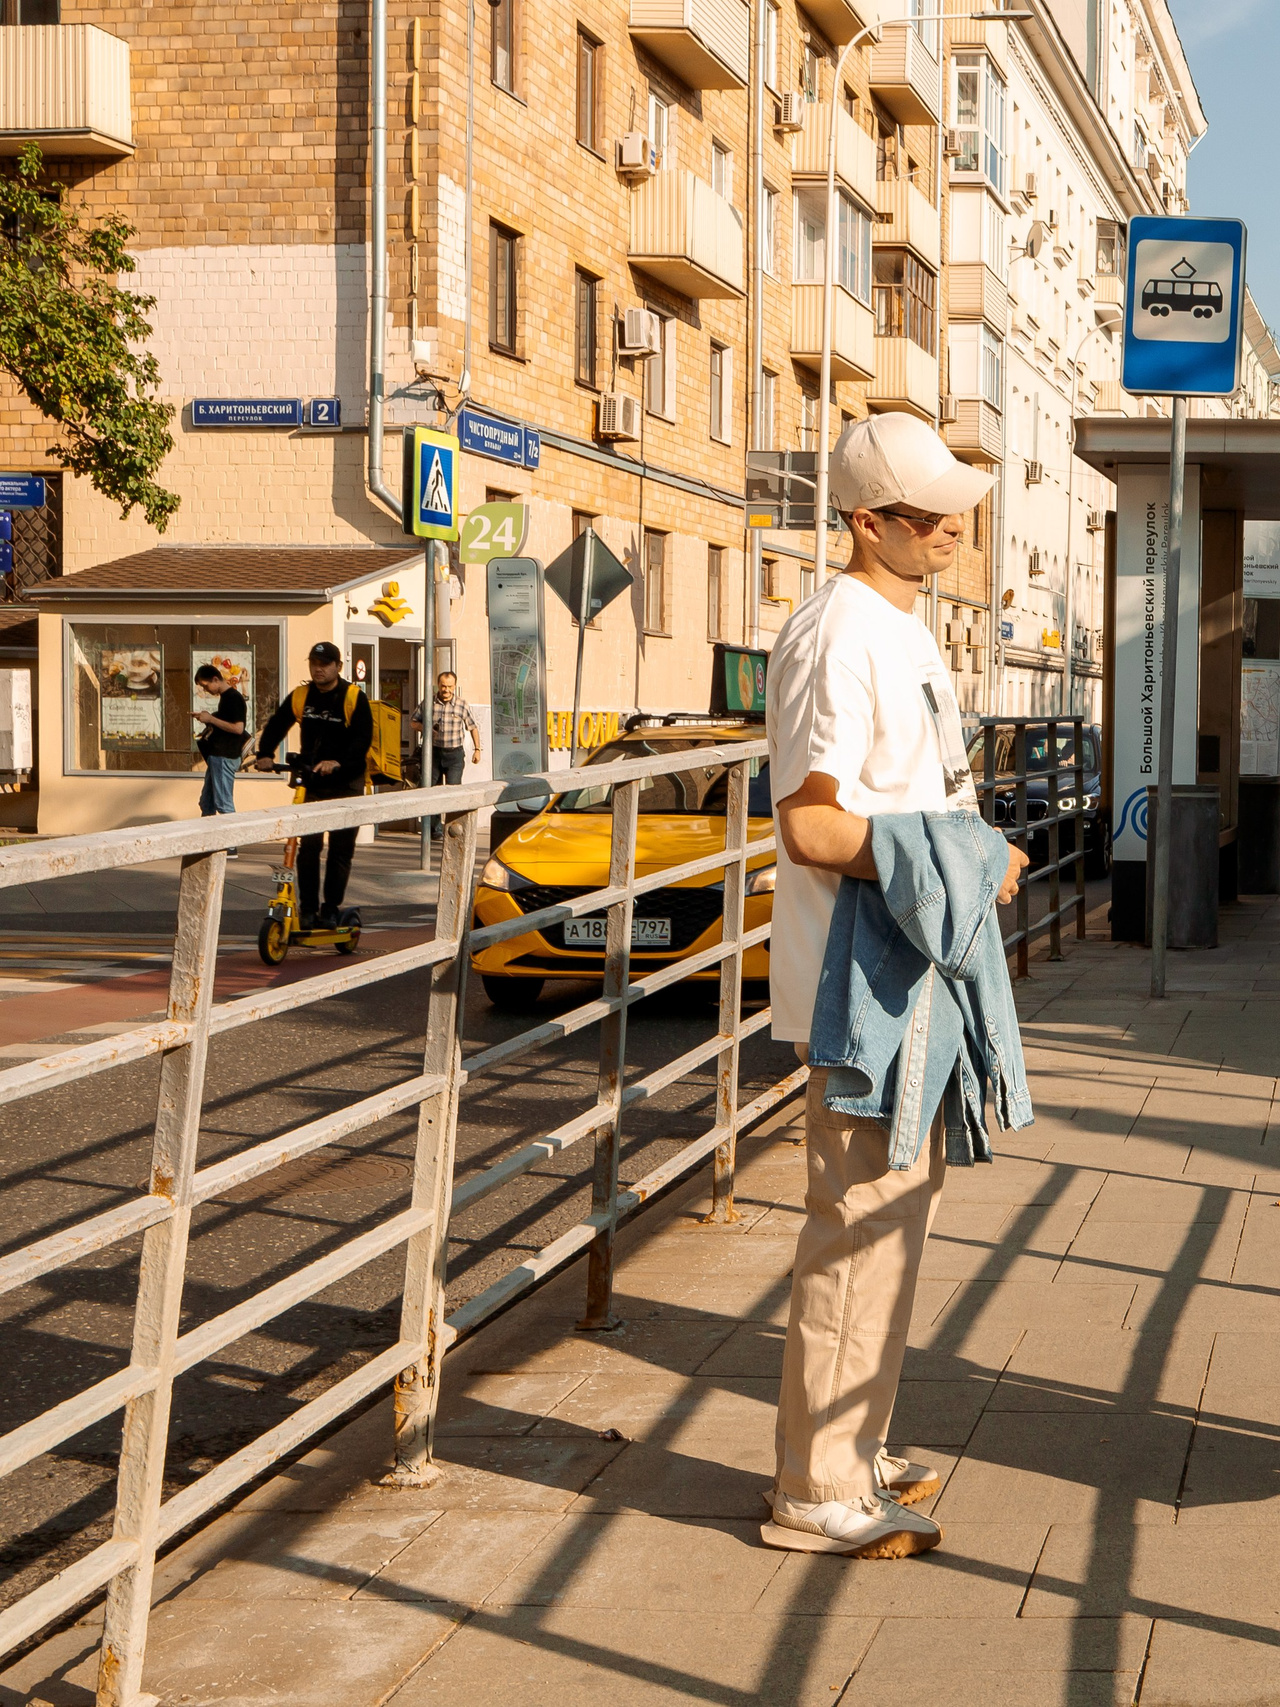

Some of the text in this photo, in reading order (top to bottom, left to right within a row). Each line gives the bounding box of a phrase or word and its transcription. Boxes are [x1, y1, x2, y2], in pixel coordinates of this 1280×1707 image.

[199, 404, 293, 415] Б. ХАРИТОНЬЕВСКИЙ
[317, 403, 329, 421] 2
[468, 419, 519, 447] ЧИСТОПРУДНЫЙ
[528, 439, 539, 459] 7/2
[468, 514, 517, 551] 24
[1140, 502, 1158, 774] Большой Харитоньевский переулок
[640, 921, 666, 934] 797
